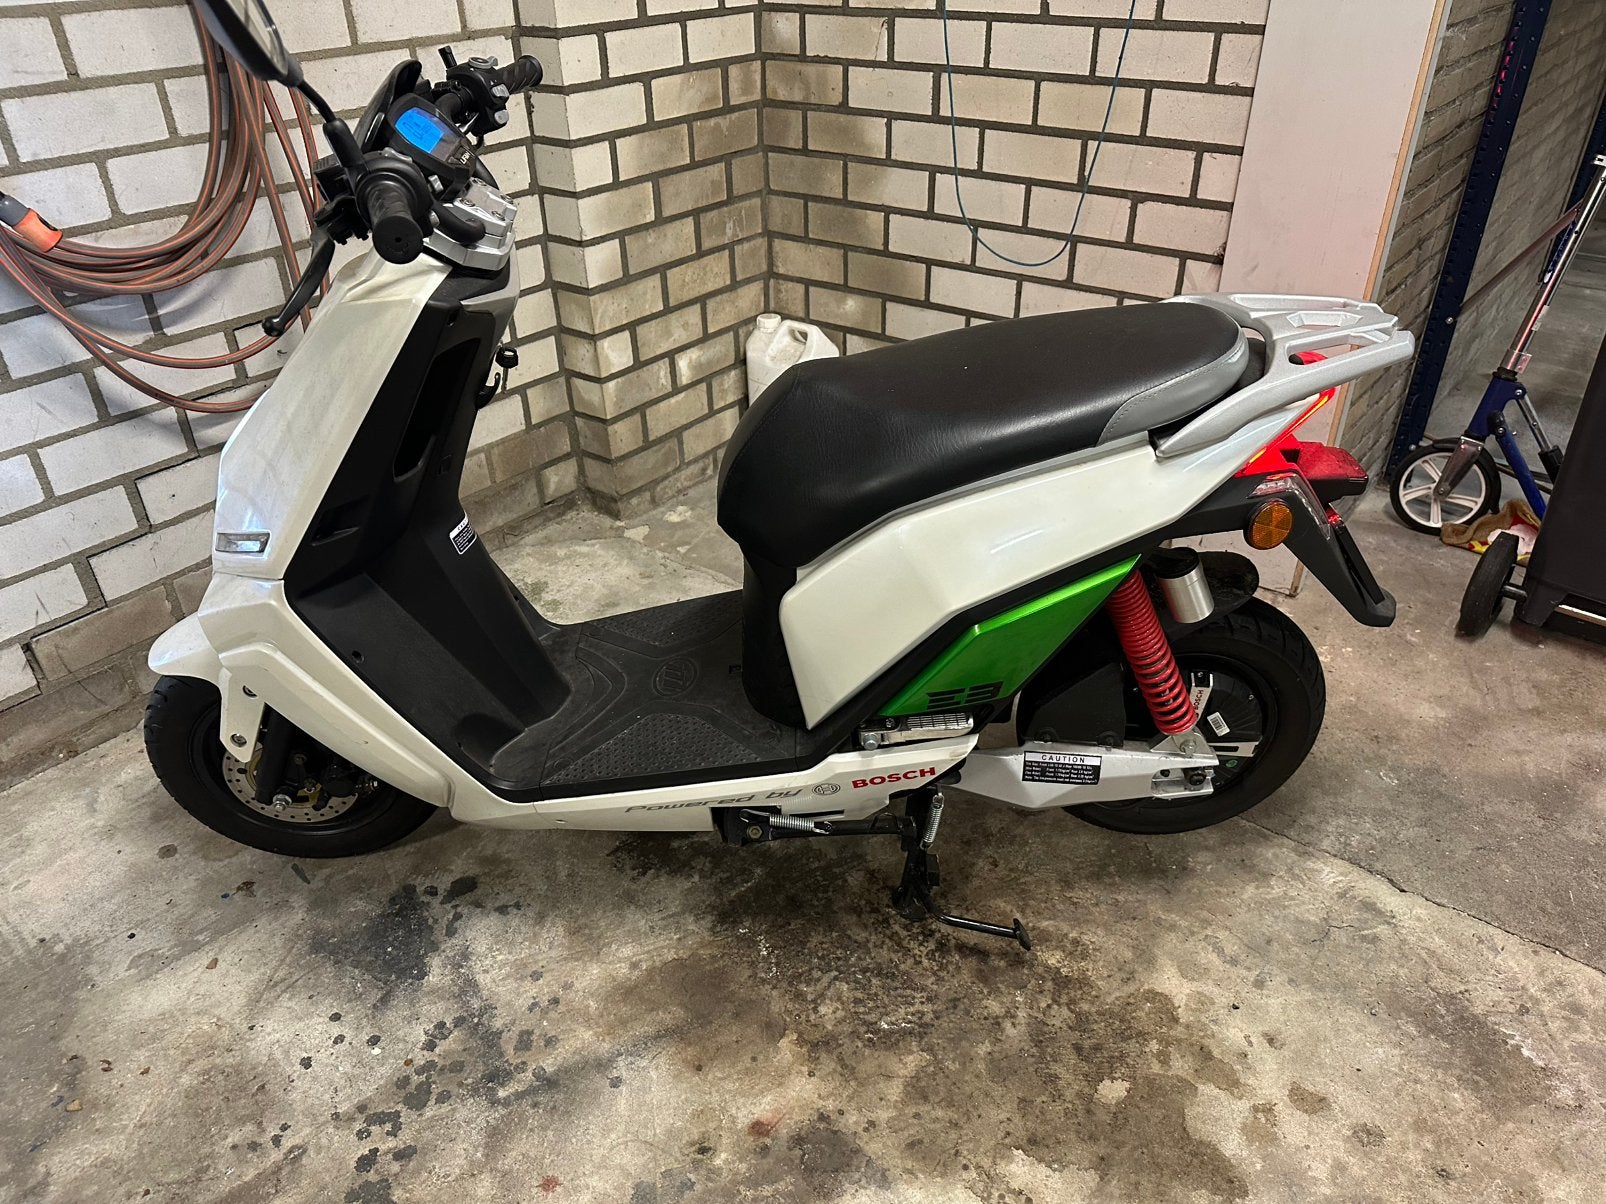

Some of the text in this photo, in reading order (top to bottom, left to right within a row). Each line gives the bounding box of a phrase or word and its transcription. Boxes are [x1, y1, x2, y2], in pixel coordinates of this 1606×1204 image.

[1041, 754, 1085, 763] CAUTION
[625, 767, 936, 813] Powered by BOSCH
